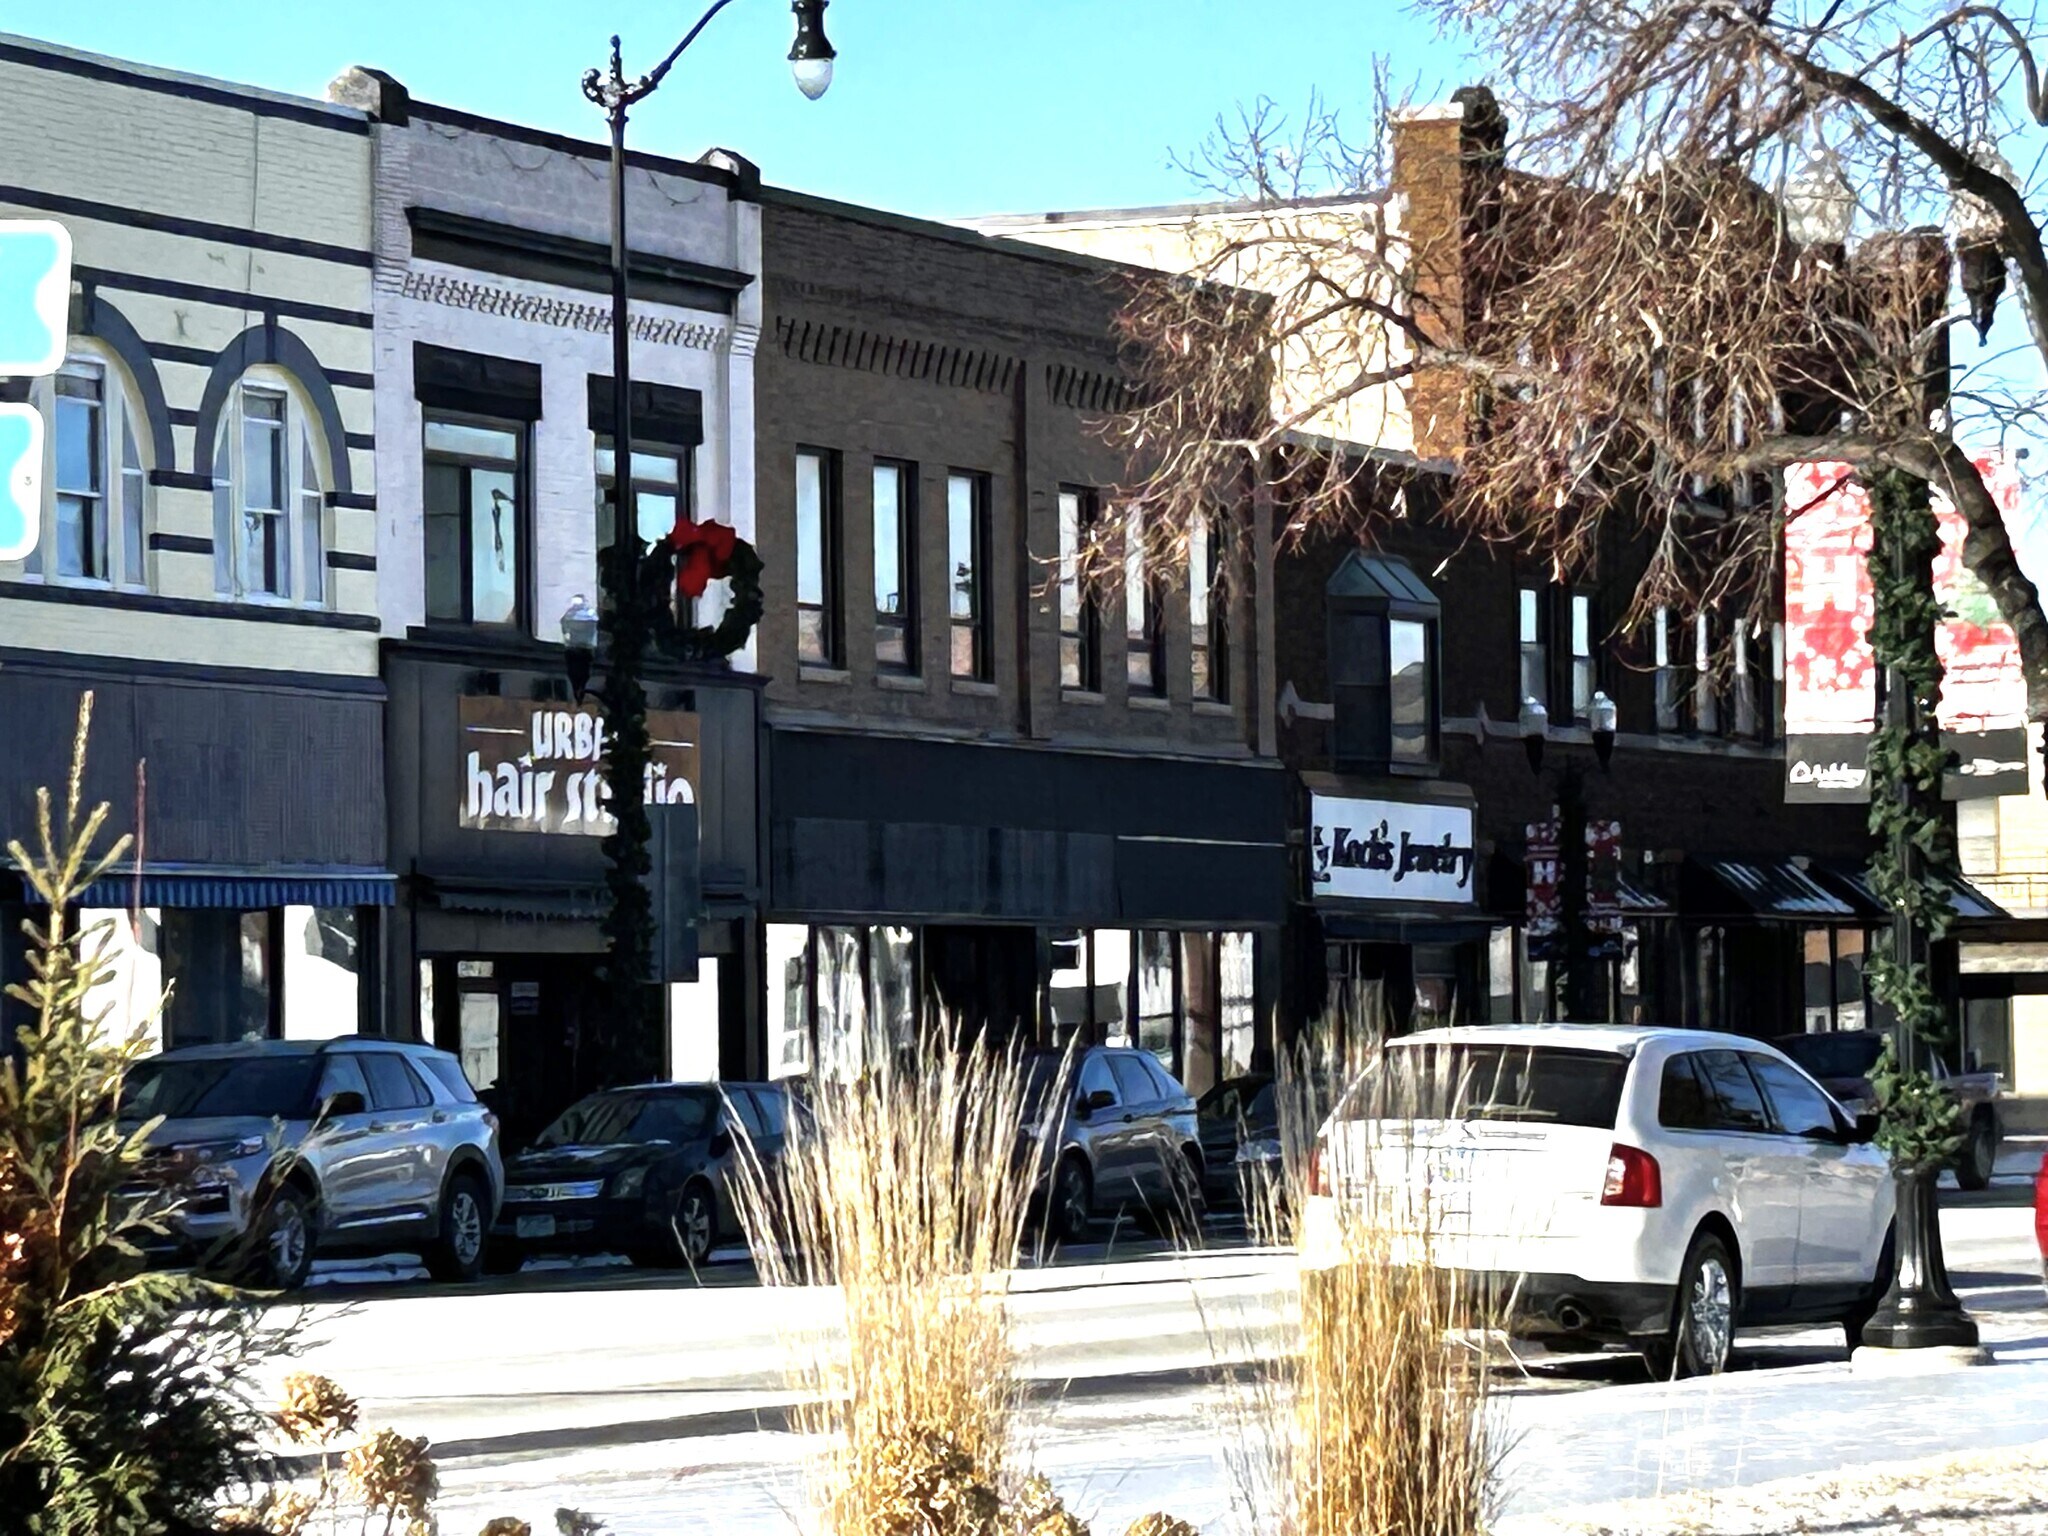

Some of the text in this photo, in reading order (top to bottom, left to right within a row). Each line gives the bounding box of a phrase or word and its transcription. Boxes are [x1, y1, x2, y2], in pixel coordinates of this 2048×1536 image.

[532, 710, 618, 762] URB
[466, 750, 695, 824] hair stio
